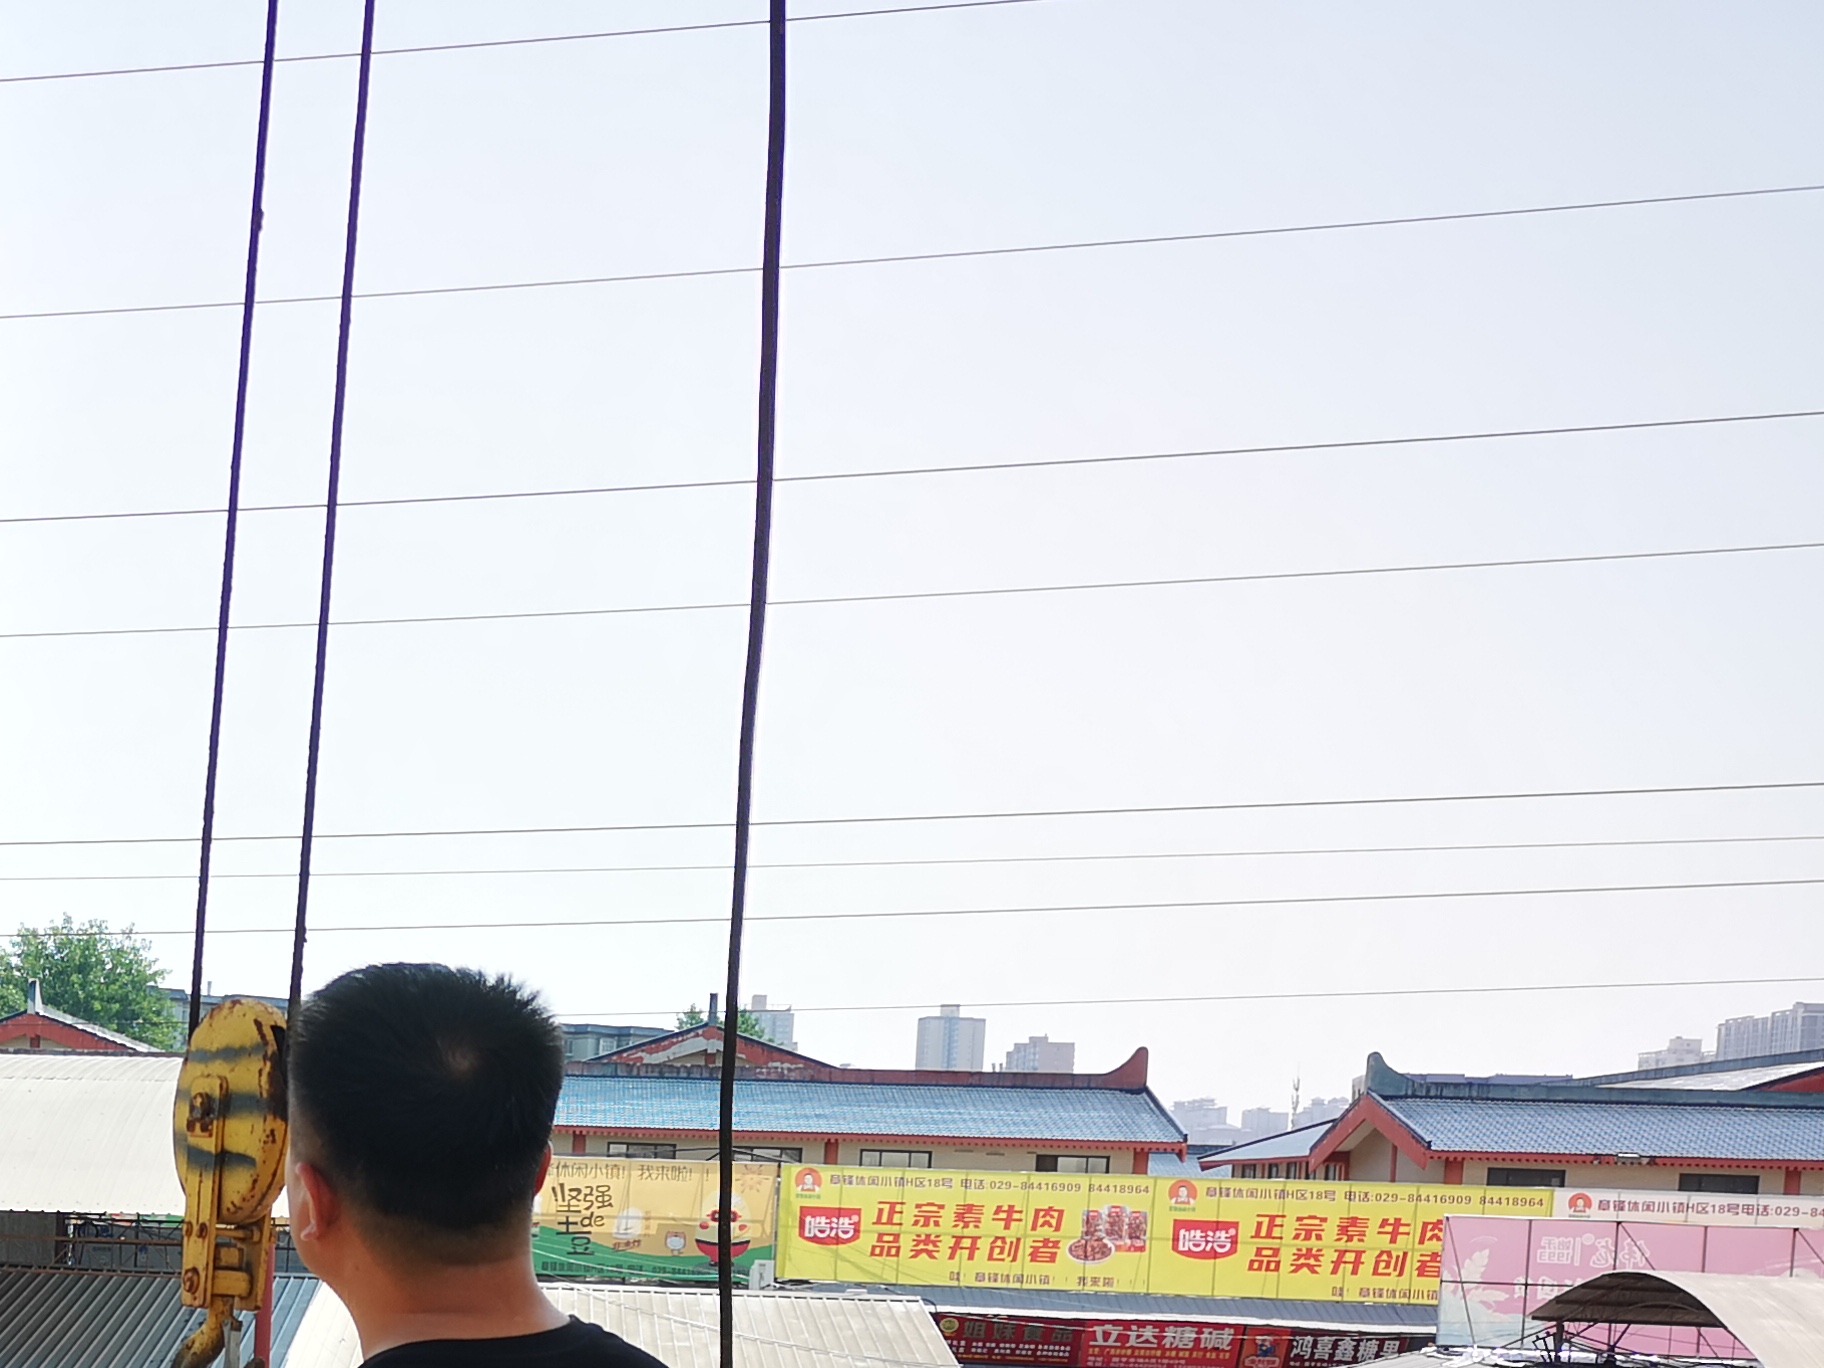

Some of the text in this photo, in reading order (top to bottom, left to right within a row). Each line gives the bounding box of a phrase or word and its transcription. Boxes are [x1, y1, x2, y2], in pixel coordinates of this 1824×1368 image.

[552, 1183, 613, 1213] 坚强
[1088, 1183, 1150, 1196] 84418964
[1479, 1196, 1544, 1208] 84418964
[556, 1211, 605, 1235] 土 de
[871, 1200, 1066, 1233] 正宗素牛肉
[1250, 1213, 1444, 1245] 正宗素牛肉
[566, 1236, 595, 1256] 豆
[869, 1232, 1063, 1265] 品类开创者
[1247, 1246, 1442, 1279] 品类开创者
[963, 1320, 1074, 1342] 姐妹食品
[1088, 1323, 1236, 1351] 立达糖碱
[1289, 1335, 1401, 1363] 鸿喜鑫糖果
